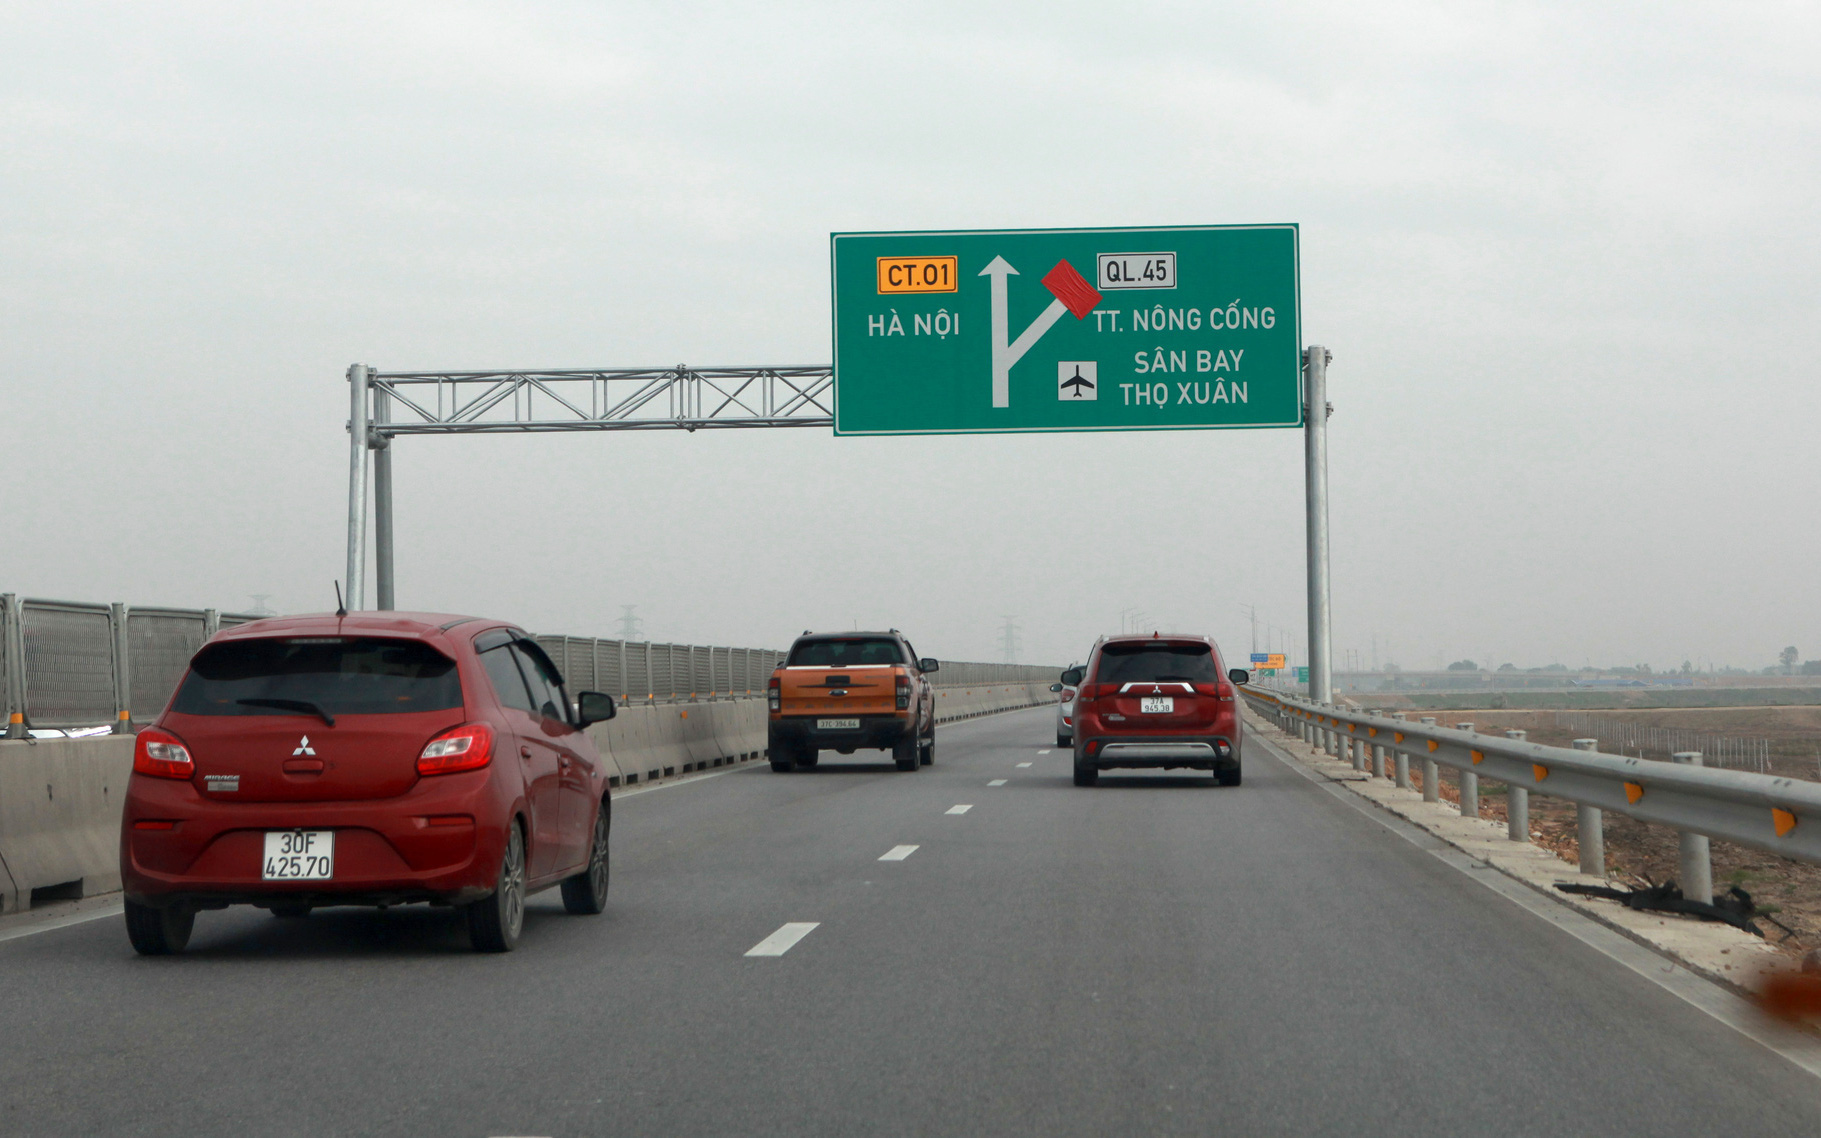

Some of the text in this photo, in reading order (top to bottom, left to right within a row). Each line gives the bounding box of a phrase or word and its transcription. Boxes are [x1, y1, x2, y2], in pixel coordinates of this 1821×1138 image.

[888, 263, 948, 287] CT.01
[1106, 260, 1167, 283] QL.45
[868, 308, 959, 340] HÀ NỘI
[1093, 298, 1276, 332] TT. NÔNG CỐNG
[1134, 346, 1244, 374] SÂN BAY
[1119, 377, 1248, 409] THỌ XUÂN
[281, 833, 317, 854] 30F
[265, 856, 330, 877] 425.70
